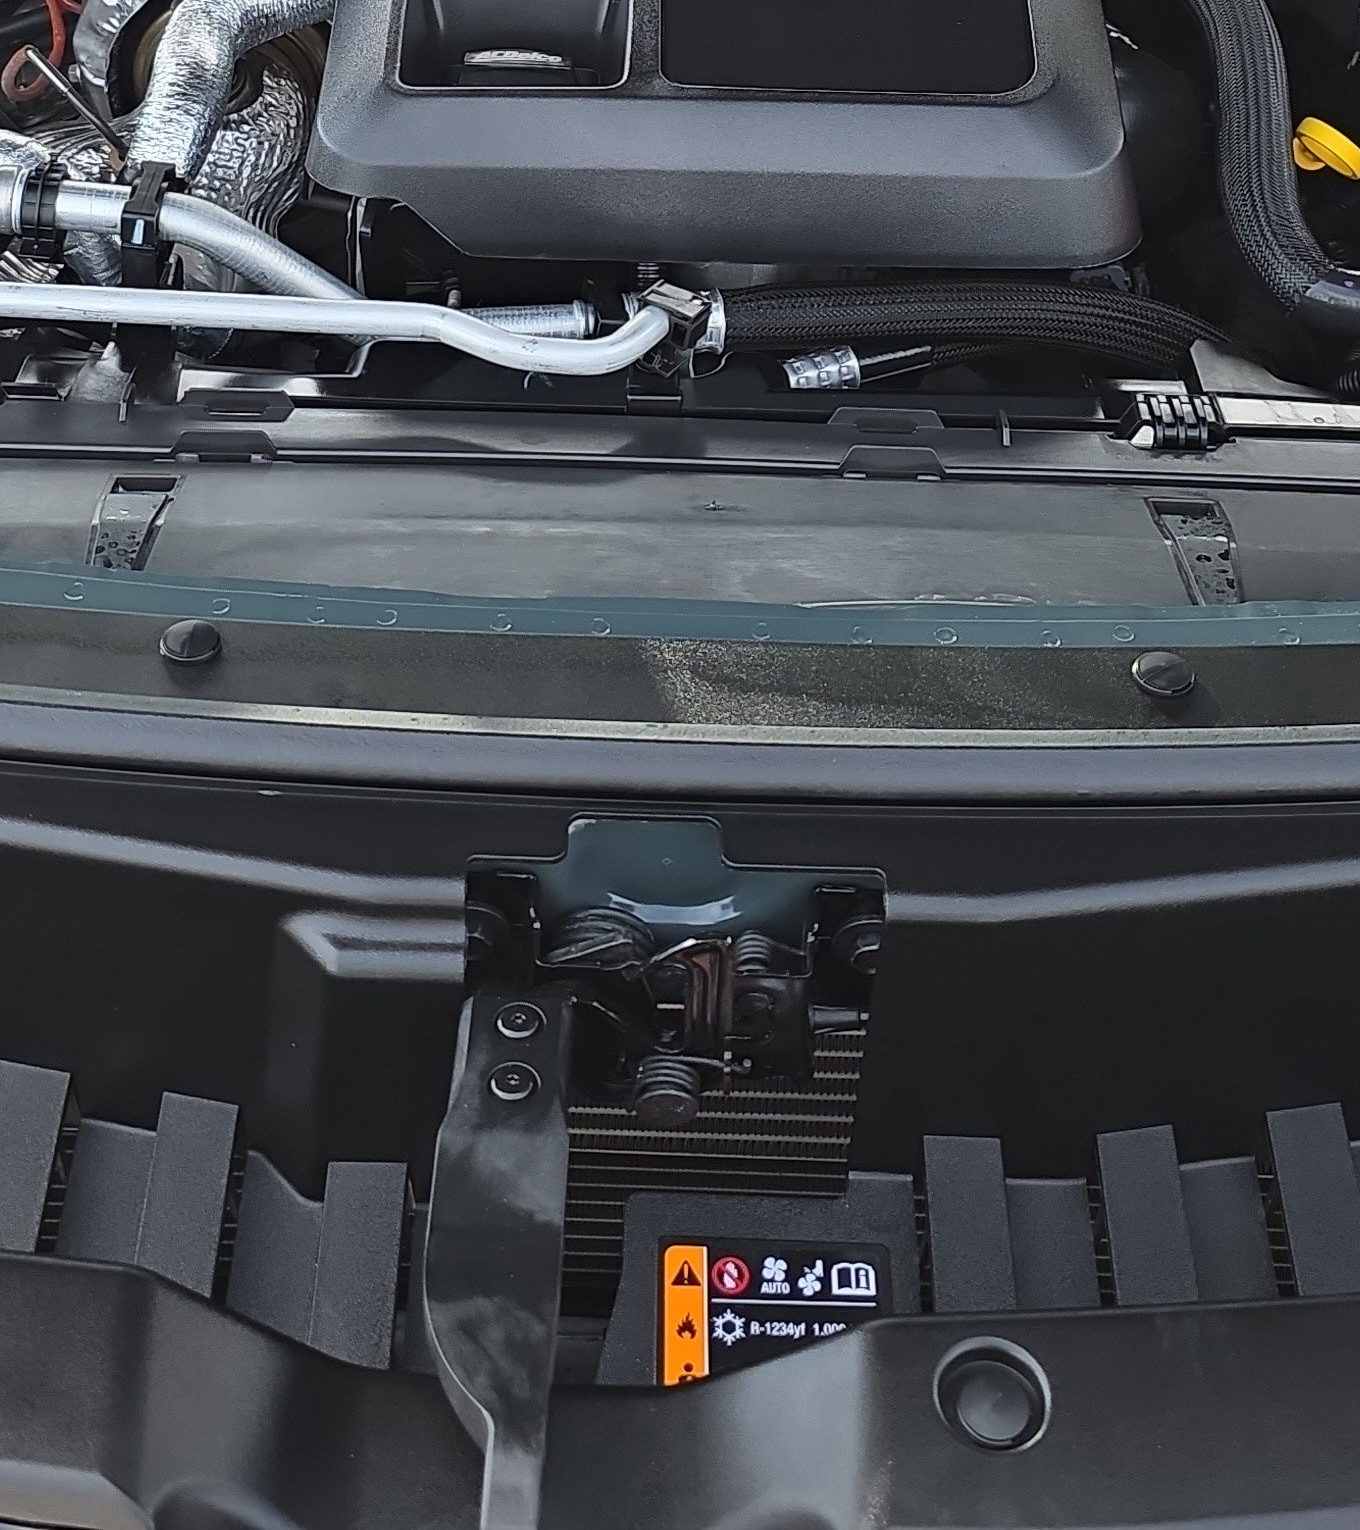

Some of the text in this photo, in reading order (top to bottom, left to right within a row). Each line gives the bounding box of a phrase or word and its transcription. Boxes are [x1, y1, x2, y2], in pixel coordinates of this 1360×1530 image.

[474, 50, 563, 63] ACDelco
[760, 1281, 791, 1295] AUTO
[749, 1321, 806, 1339] R-1234yf
